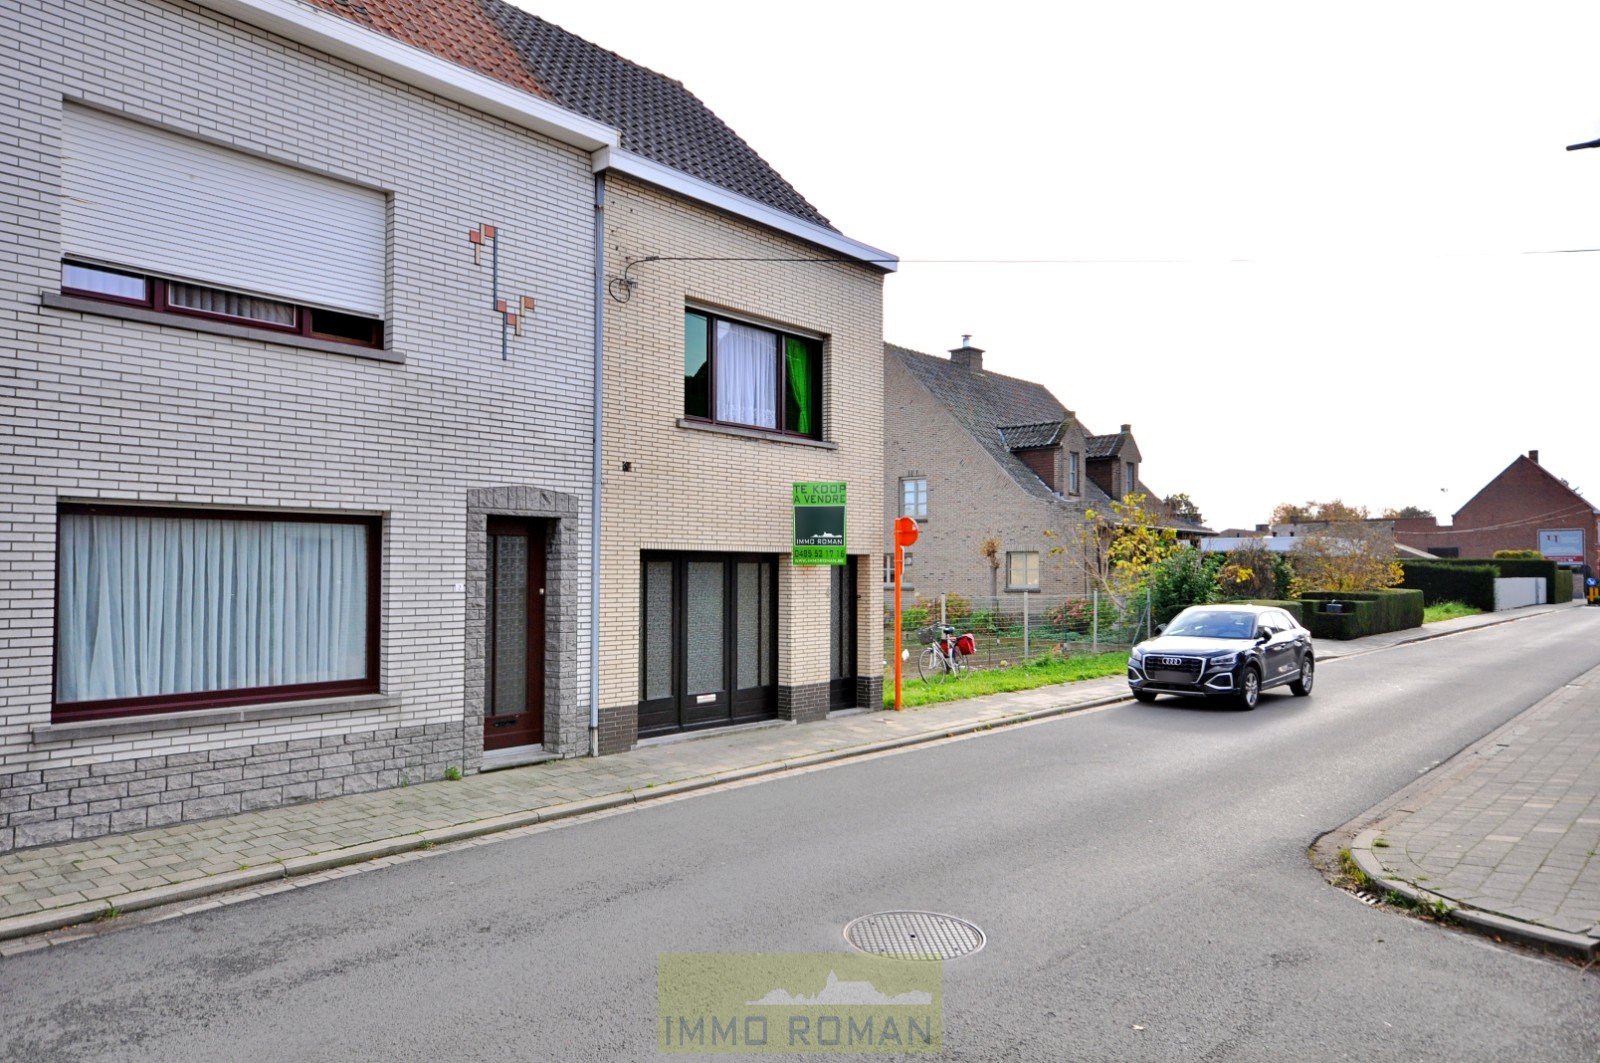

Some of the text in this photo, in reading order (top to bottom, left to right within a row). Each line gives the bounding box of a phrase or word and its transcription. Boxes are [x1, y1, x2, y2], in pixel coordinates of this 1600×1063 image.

[793, 485, 846, 494] TE KOOP
[804, 495, 846, 504] VENDRE
[794, 549, 812, 558] 0485
[814, 549, 823, 558] 53
[826, 549, 834, 558] 17
